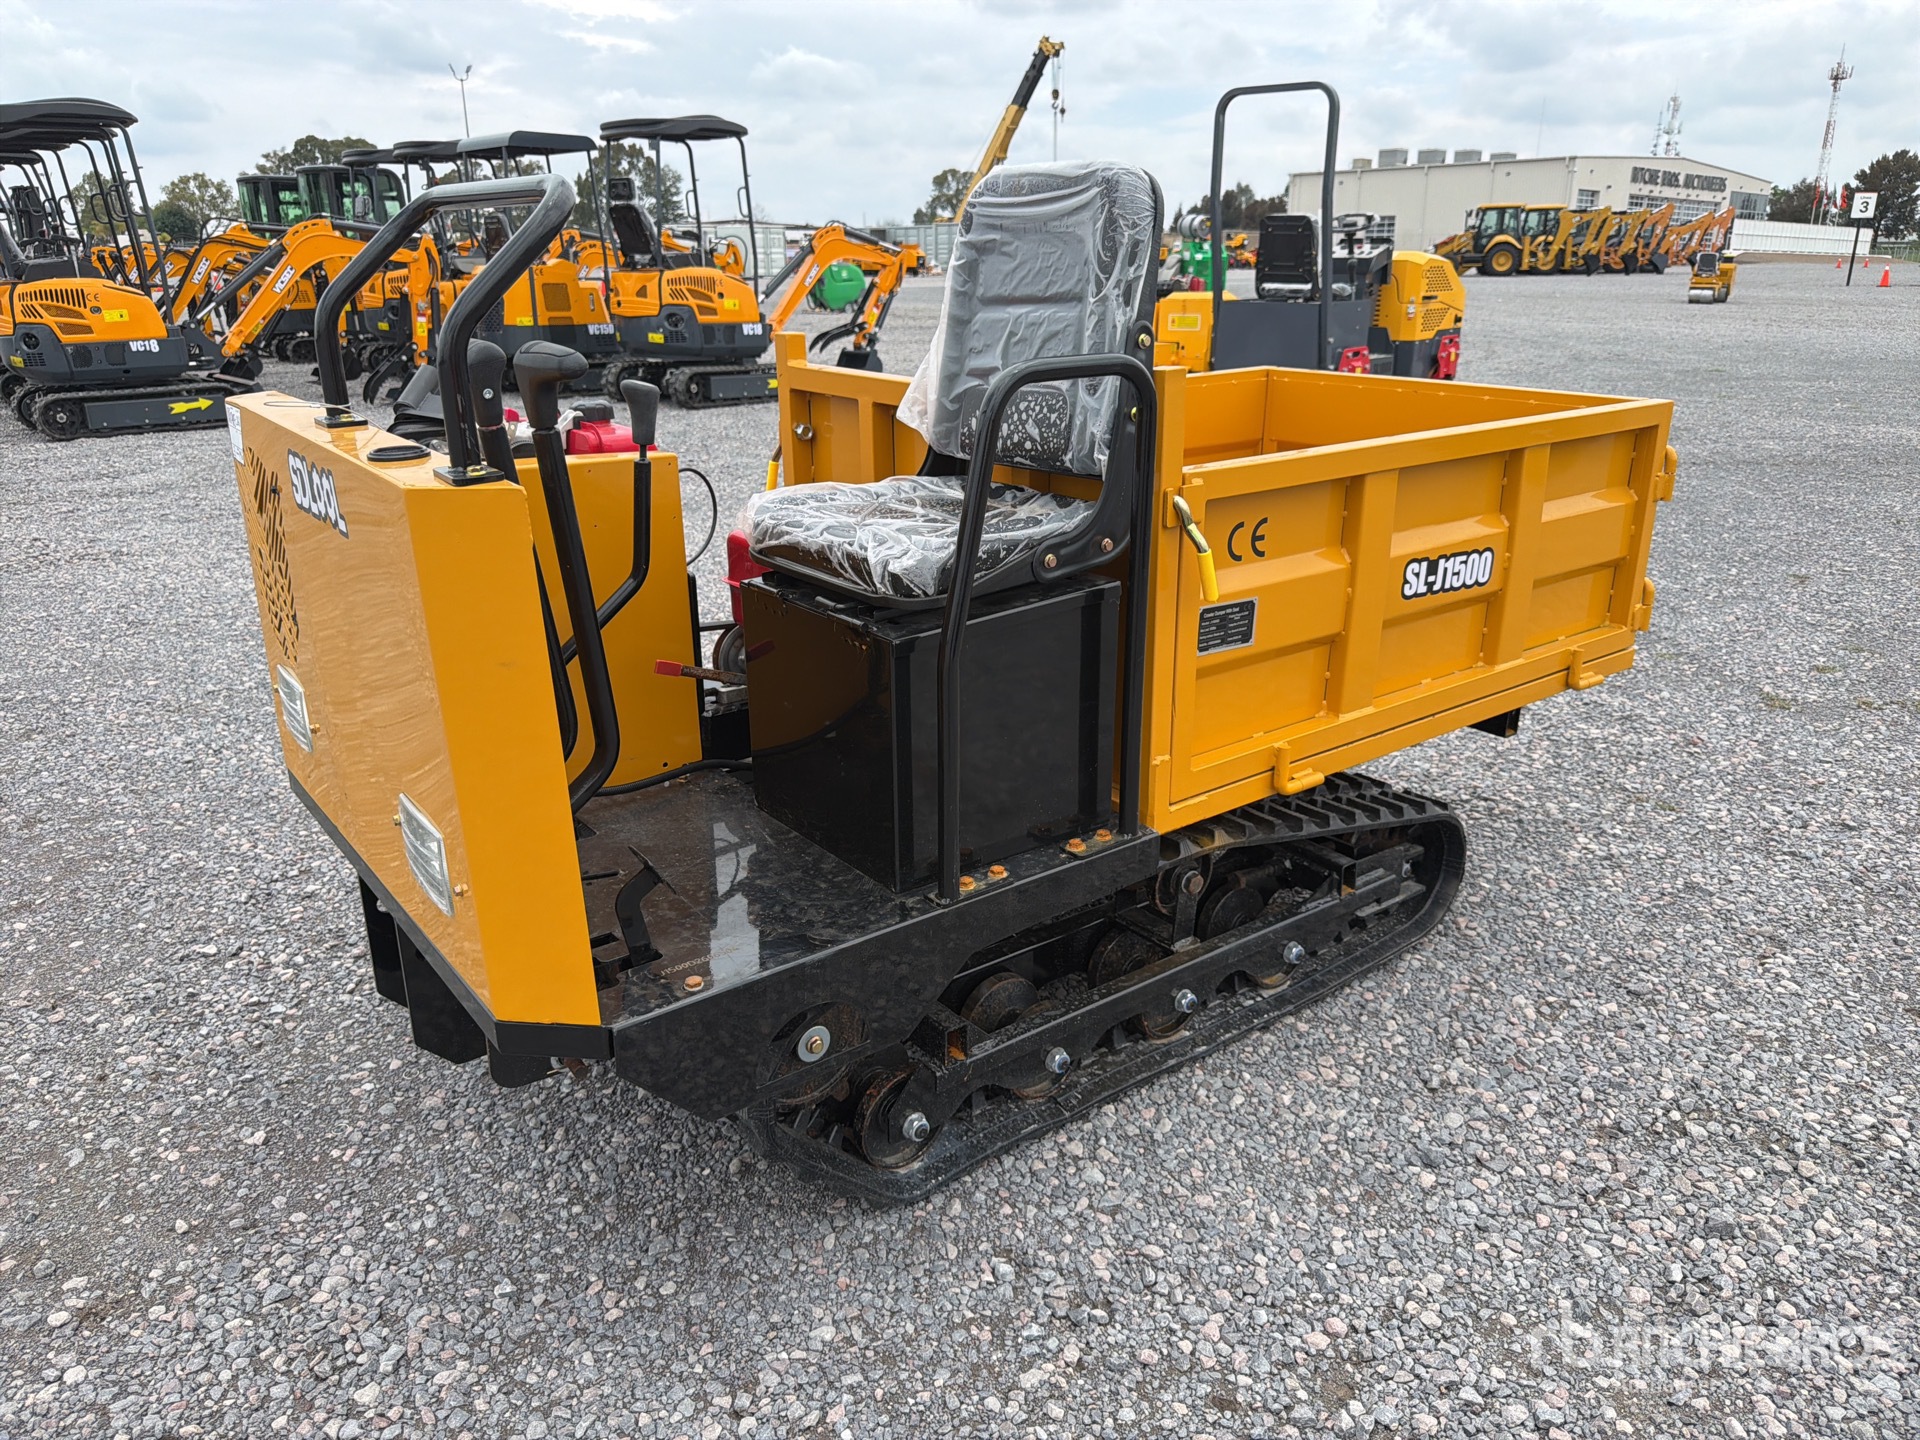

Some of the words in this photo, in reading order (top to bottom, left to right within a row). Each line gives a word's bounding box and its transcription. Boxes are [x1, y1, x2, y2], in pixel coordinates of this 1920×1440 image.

[1859, 200, 1870, 213] 3
[129, 339, 160, 353] VC18
[1227, 517, 1268, 561] CE
[1402, 547, 1494, 600] SL-J1500
